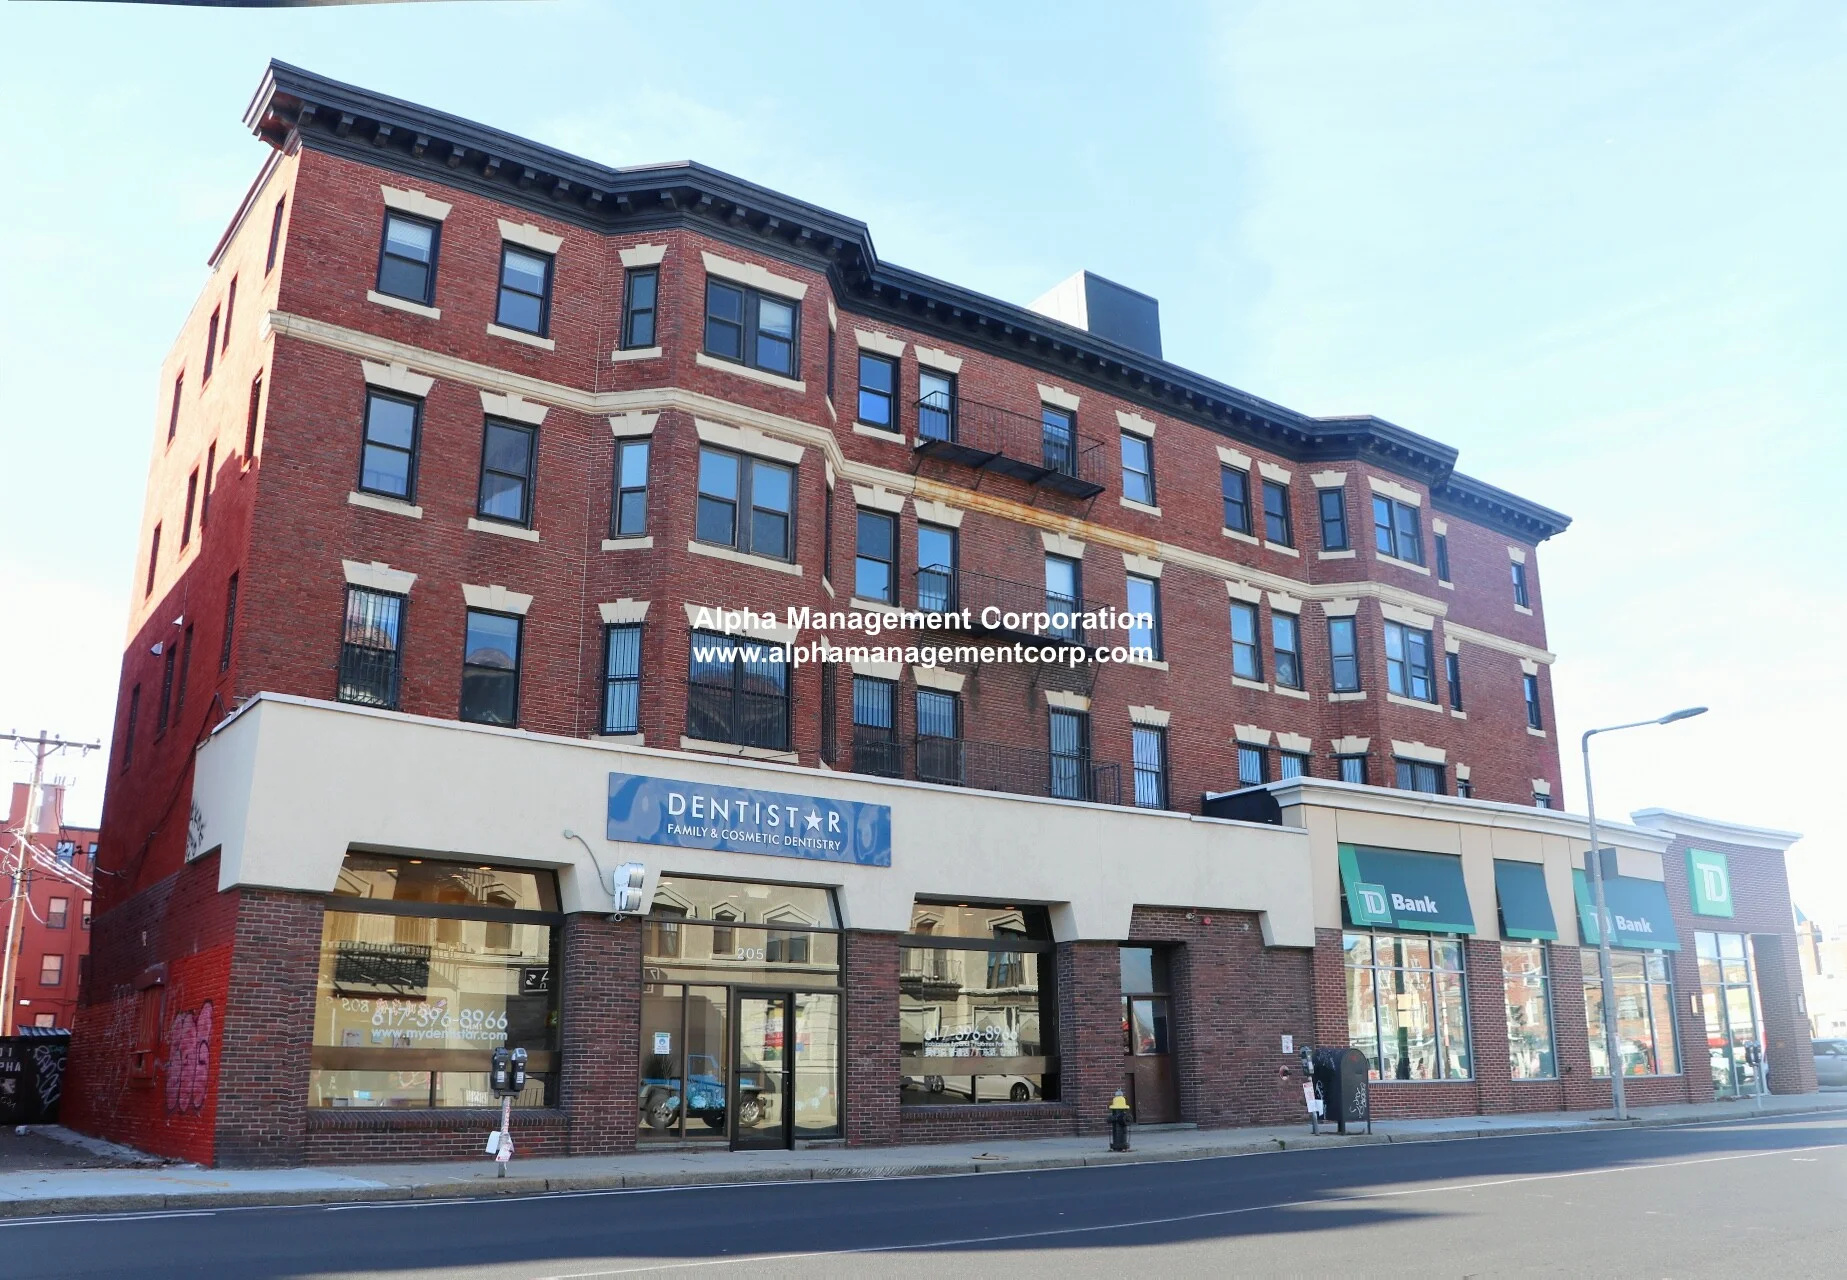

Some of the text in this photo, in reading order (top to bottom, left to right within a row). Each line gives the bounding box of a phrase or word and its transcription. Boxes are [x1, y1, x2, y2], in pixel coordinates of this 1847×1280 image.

[667, 823, 841, 851] FAMILY & COSMETIC DENTISTRY
[1696, 862, 1728, 902] TD
[1358, 890, 1439, 914] TD Bank
[1615, 915, 1653, 933] Bank
[737, 947, 764, 960] 205
[372, 1007, 508, 1030] 617-396-8966
